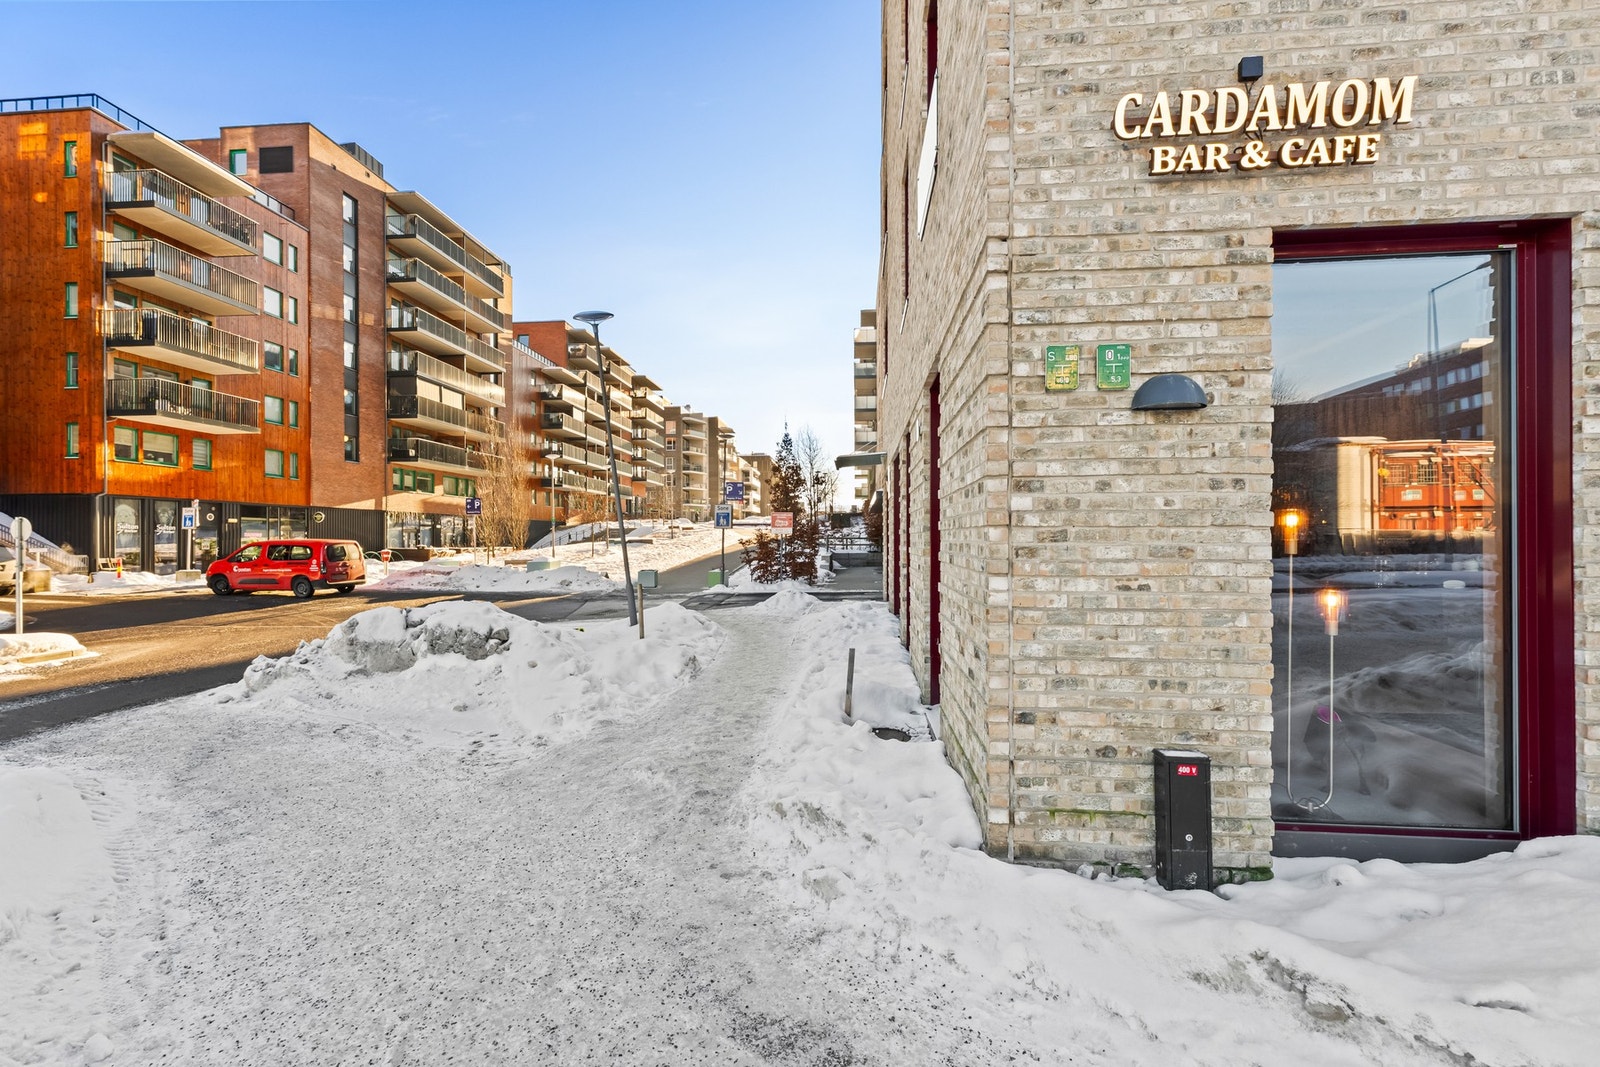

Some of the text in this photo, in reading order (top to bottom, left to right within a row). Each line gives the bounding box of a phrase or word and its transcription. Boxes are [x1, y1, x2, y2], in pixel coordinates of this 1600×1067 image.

[1112, 75, 1418, 140] CARDAMOM
[1150, 133, 1381, 175] BAR & CAFE
[1048, 351, 1056, 361] S
[727, 486, 733, 495] P
[474, 501, 480, 509] P
